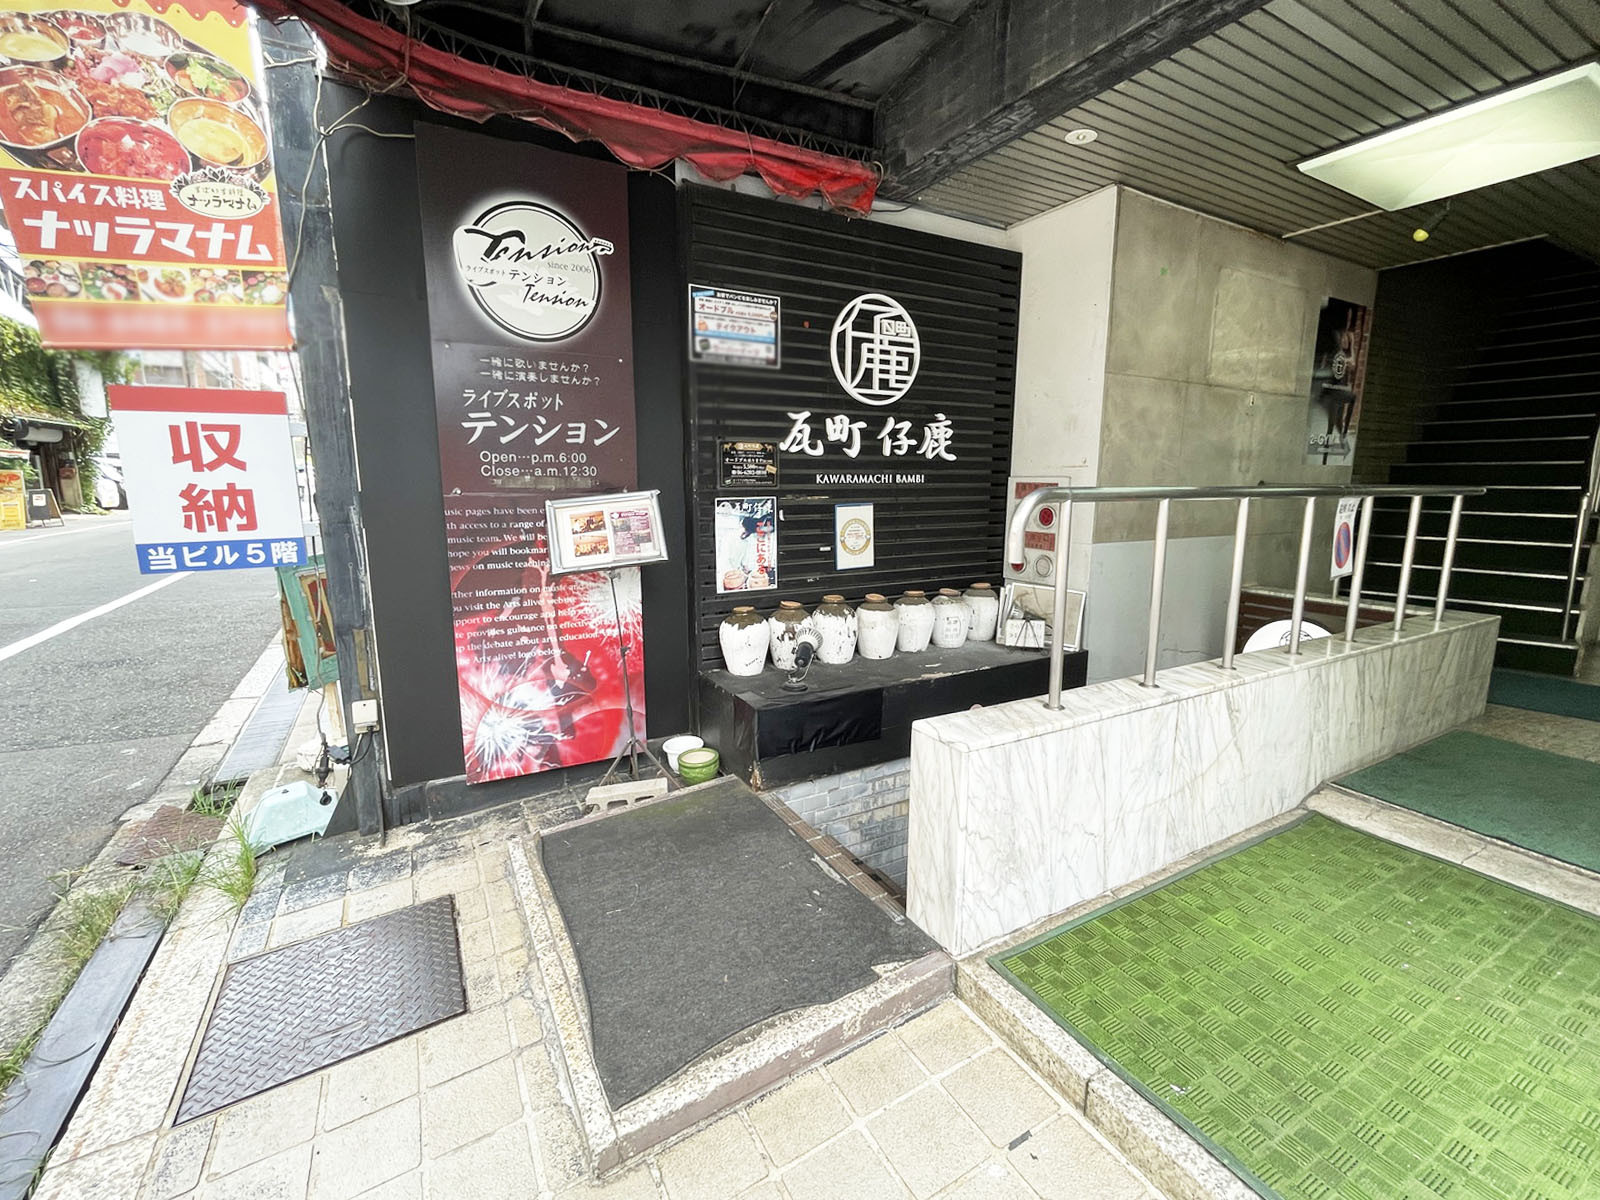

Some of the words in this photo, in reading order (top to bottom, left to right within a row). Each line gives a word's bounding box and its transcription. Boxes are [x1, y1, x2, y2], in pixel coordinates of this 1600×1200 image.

[9, 177, 168, 211] スパイス料理
[22, 211, 275, 261] ナツラマナム
[548, 262, 569, 270] since
[571, 264, 592, 273] 2006
[509, 269, 567, 287] テンション
[522, 283, 589, 308] Tension
[462, 389, 564, 411] ライブスポット
[461, 412, 621, 446] テンション
[816, 474, 893, 484] KAWARAMACHI
[895, 474, 925, 484] BAMBI
[465, 508, 491, 516] pages
[493, 507, 514, 515] have
[510, 521, 534, 529] range
[447, 536, 475, 544] music
[503, 534, 518, 542] We
[147, 542, 299, 570] 当ビル5階
[491, 547, 508, 555] will
[487, 561, 513, 569] music
[475, 587, 528, 597] information
[486, 601, 500, 610] the
